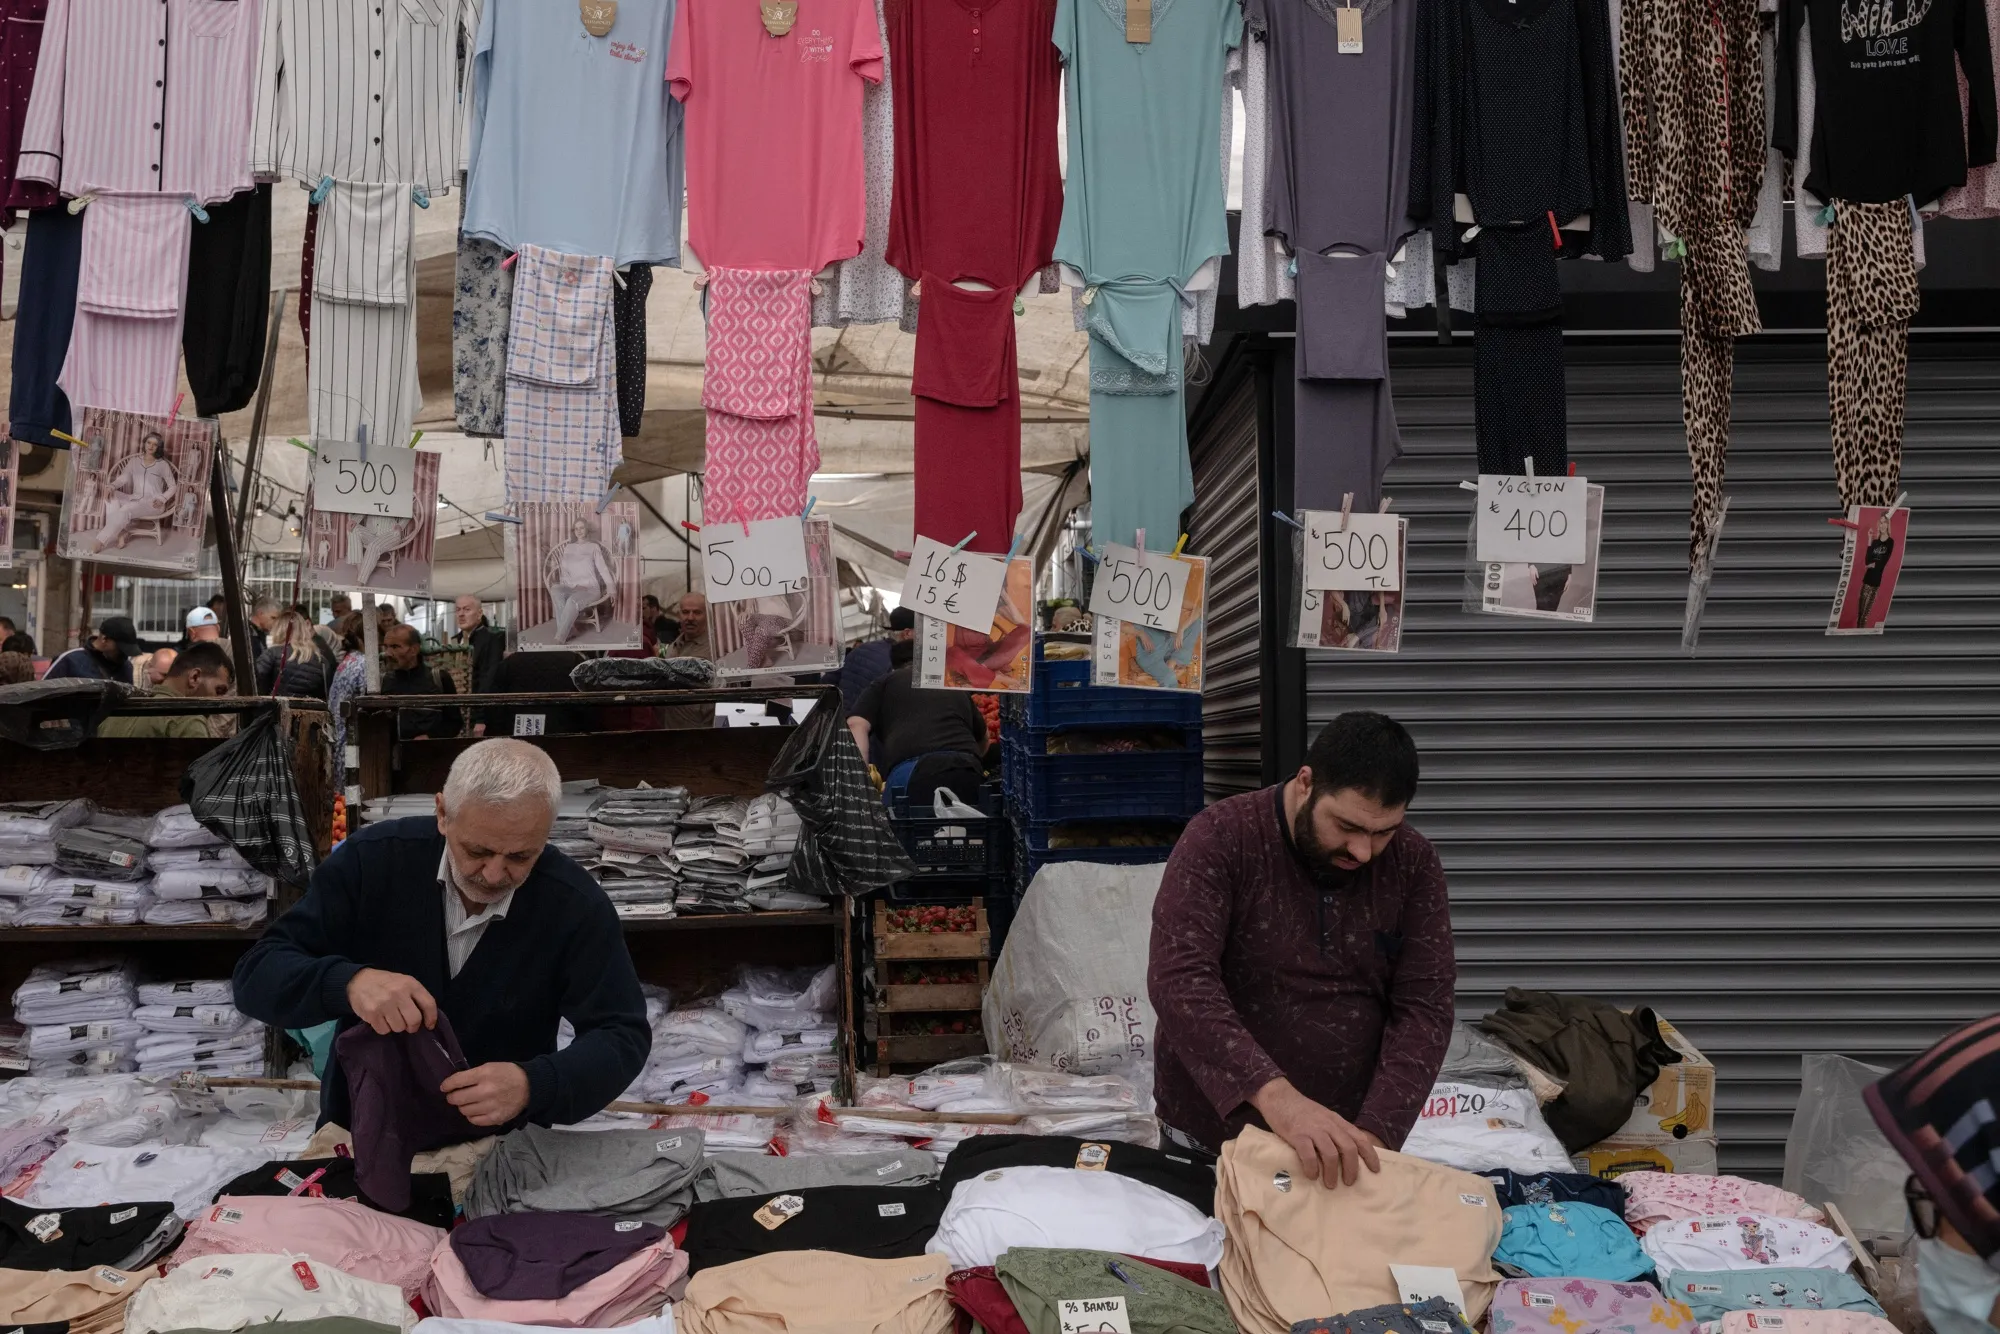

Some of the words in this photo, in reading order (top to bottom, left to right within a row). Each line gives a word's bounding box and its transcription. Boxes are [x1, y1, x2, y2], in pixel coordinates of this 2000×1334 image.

[797, 36, 834, 45] EVERYTHING
[335, 459, 397, 496] 500
[374, 503, 390, 513] TL
[1503, 508, 1568, 541] 400
[708, 540, 772, 587] 500
[1322, 531, 1388, 571] 500
[1842, 538, 1855, 578] NIGHT
[920, 551, 950, 583] 16
[1487, 564, 1502, 591] GOO
[916, 584, 937, 604] 15
[1107, 559, 1172, 611] 500
[1365, 576, 1391, 588] TL
[1143, 613, 1163, 627] TL
[1083, 1301, 1119, 1314] BAMBU
